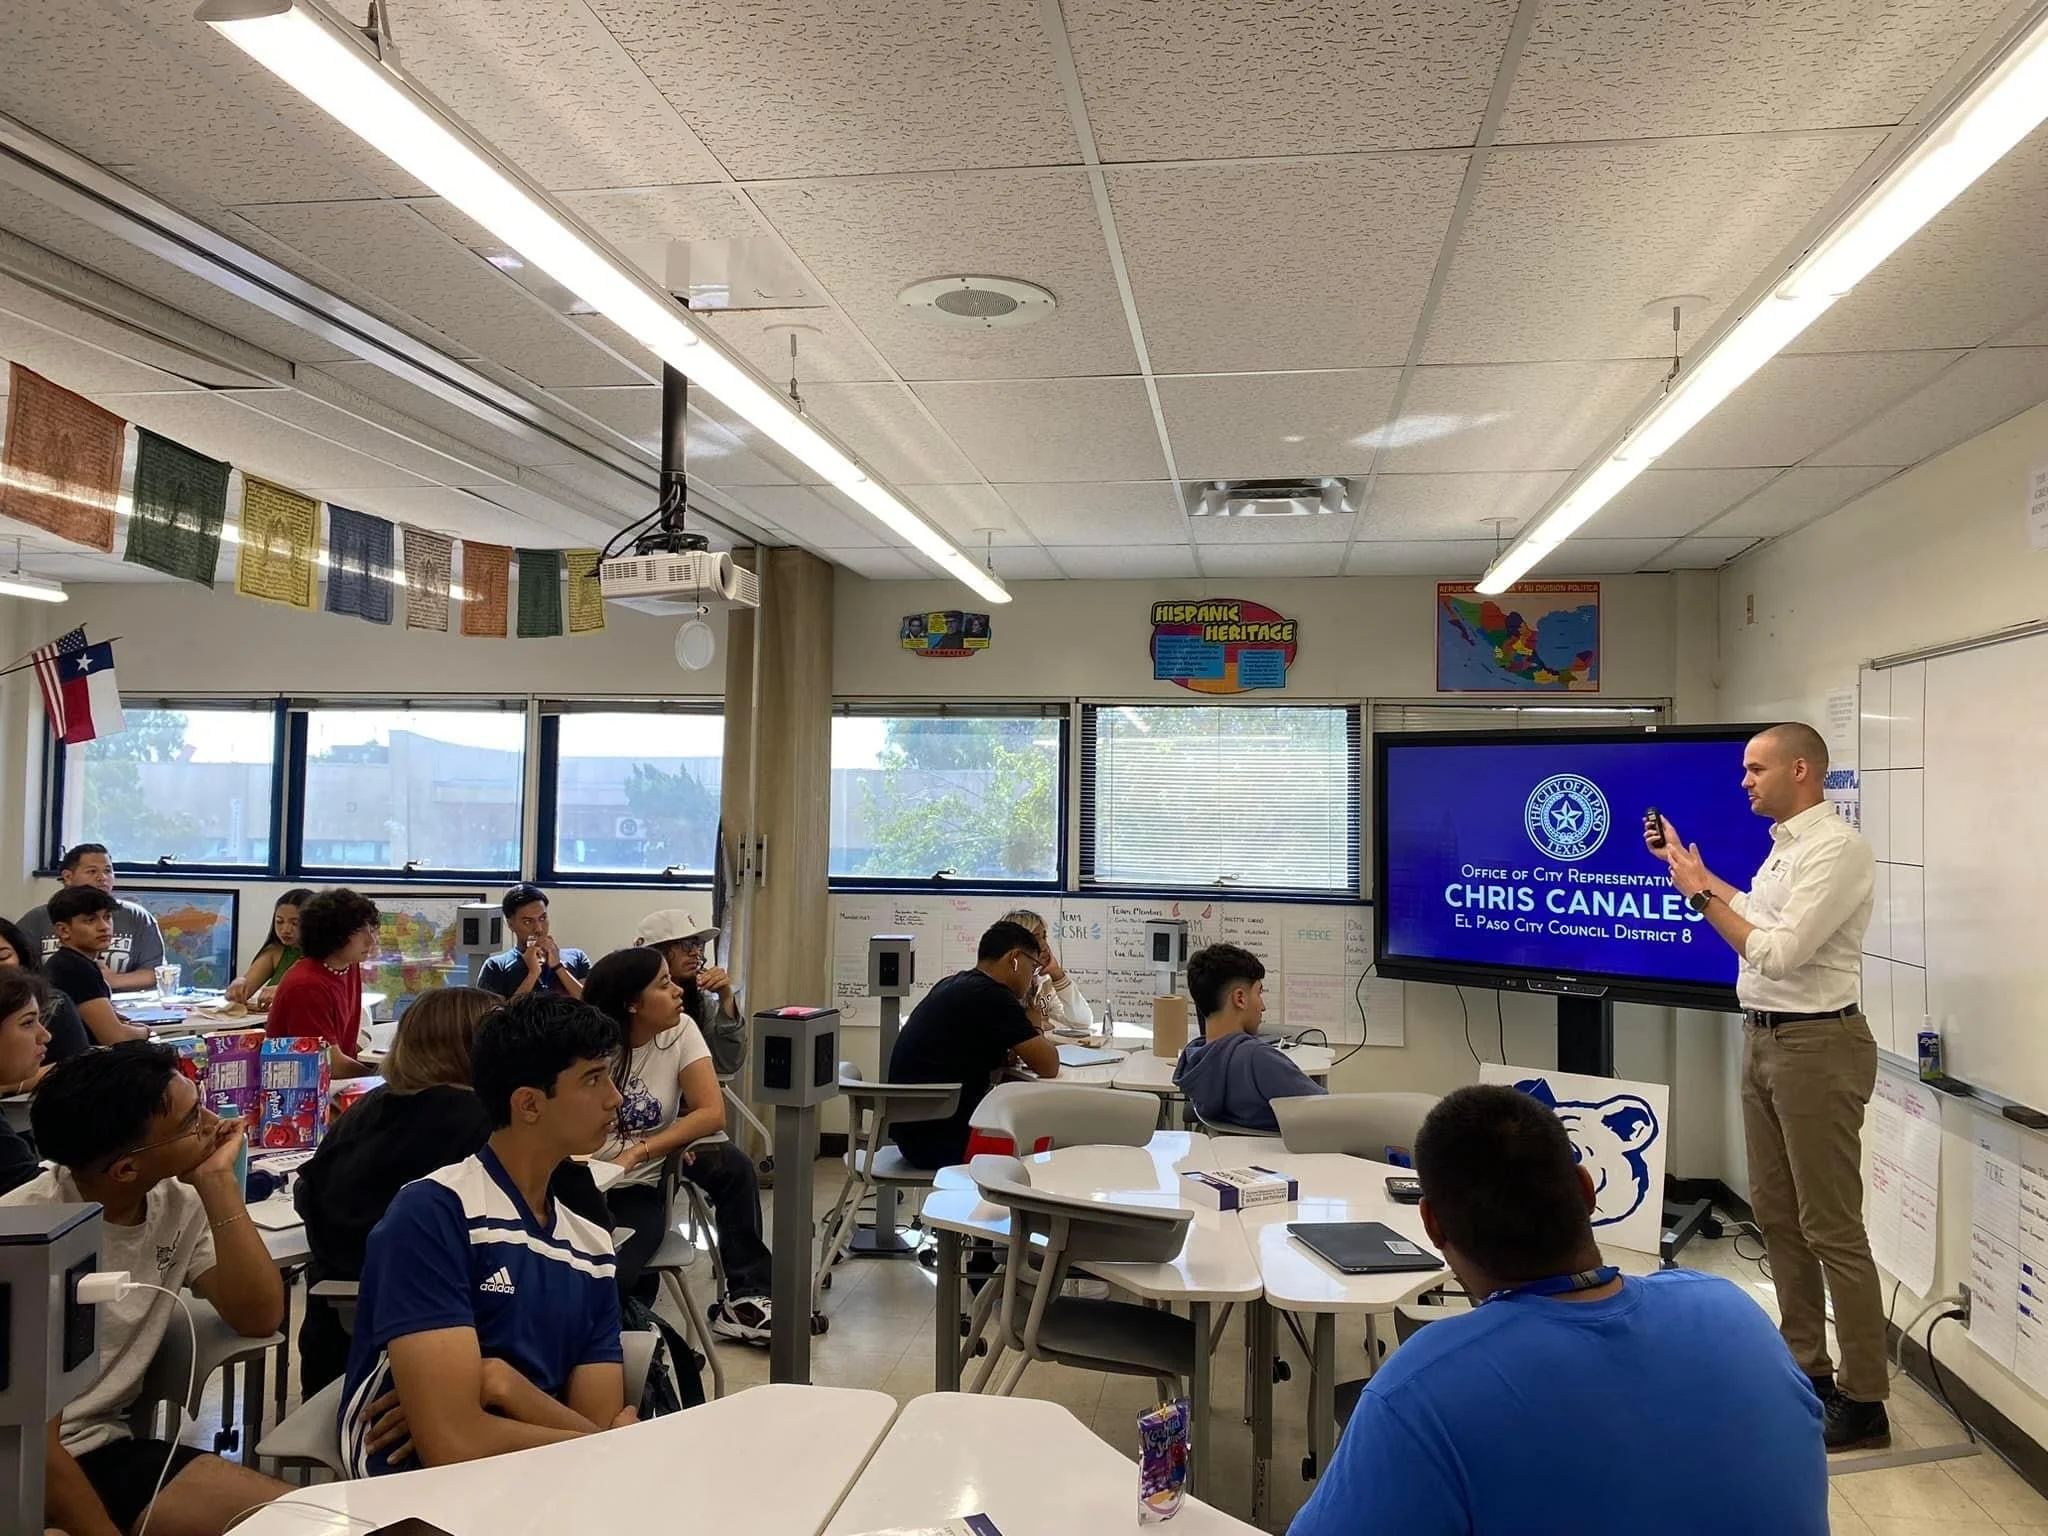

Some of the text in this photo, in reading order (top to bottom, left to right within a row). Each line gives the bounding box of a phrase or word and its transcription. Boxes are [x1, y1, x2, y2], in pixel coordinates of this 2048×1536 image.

[1439, 584, 1475, 593] REPUBLIC
[1524, 583, 1535, 592] SU
[1154, 604, 1240, 623] HISPANIC
[1204, 623, 1294, 642] HERITAGE
[1530, 780, 1604, 831] THE CITY OF EL PASO
[1547, 839, 1586, 855] TEXAS
[1568, 868, 1674, 887] REPRESENTATIV
[1444, 883, 1705, 922] CHRIS CANALES
[1681, 928, 1693, 944] 8
[480, 1282, 516, 1295] adidas
